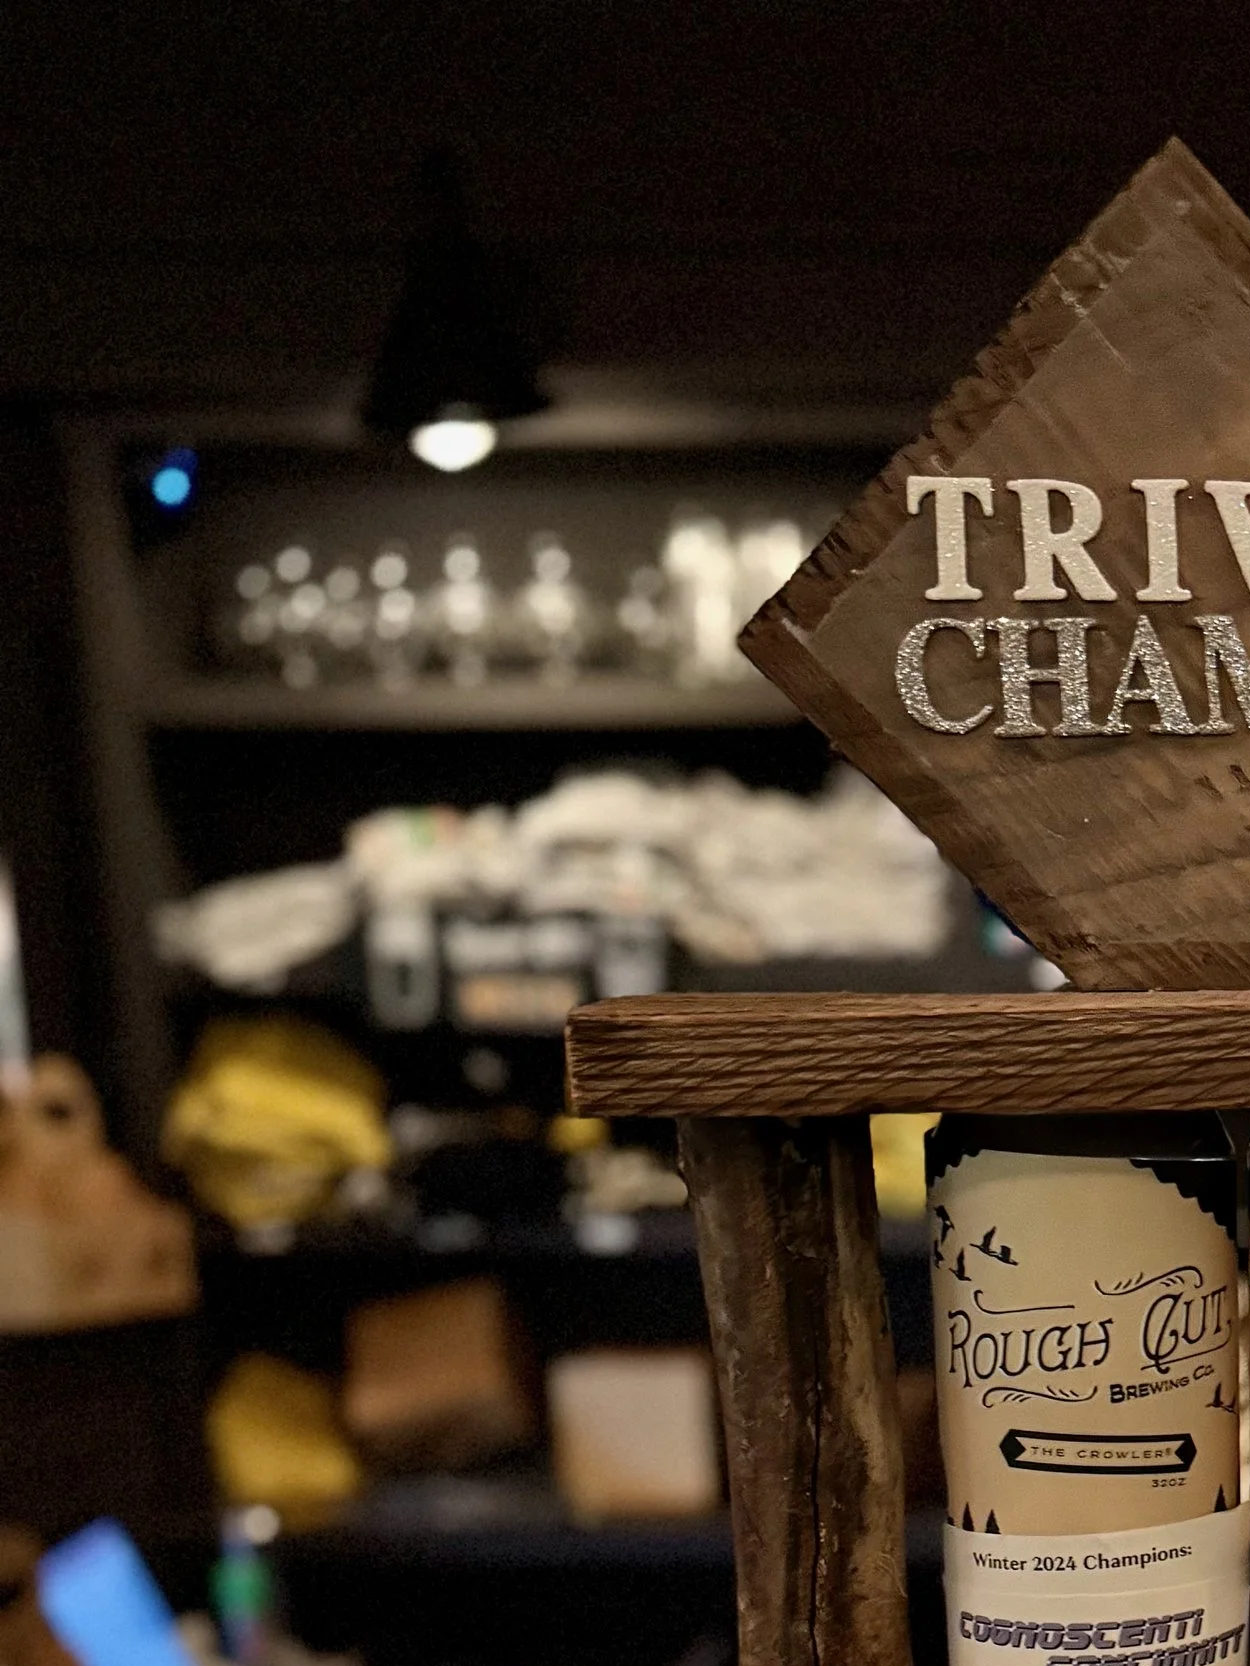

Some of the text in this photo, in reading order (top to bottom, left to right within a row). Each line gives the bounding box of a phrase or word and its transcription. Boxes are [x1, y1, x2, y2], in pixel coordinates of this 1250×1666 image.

[948, 1310, 1114, 1388] ROUGH
[1110, 1375, 1190, 1403] BREWING
[1030, 1446, 1065, 1457] THE
[973, 1545, 1193, 1571] Winter 2024 Champions:
